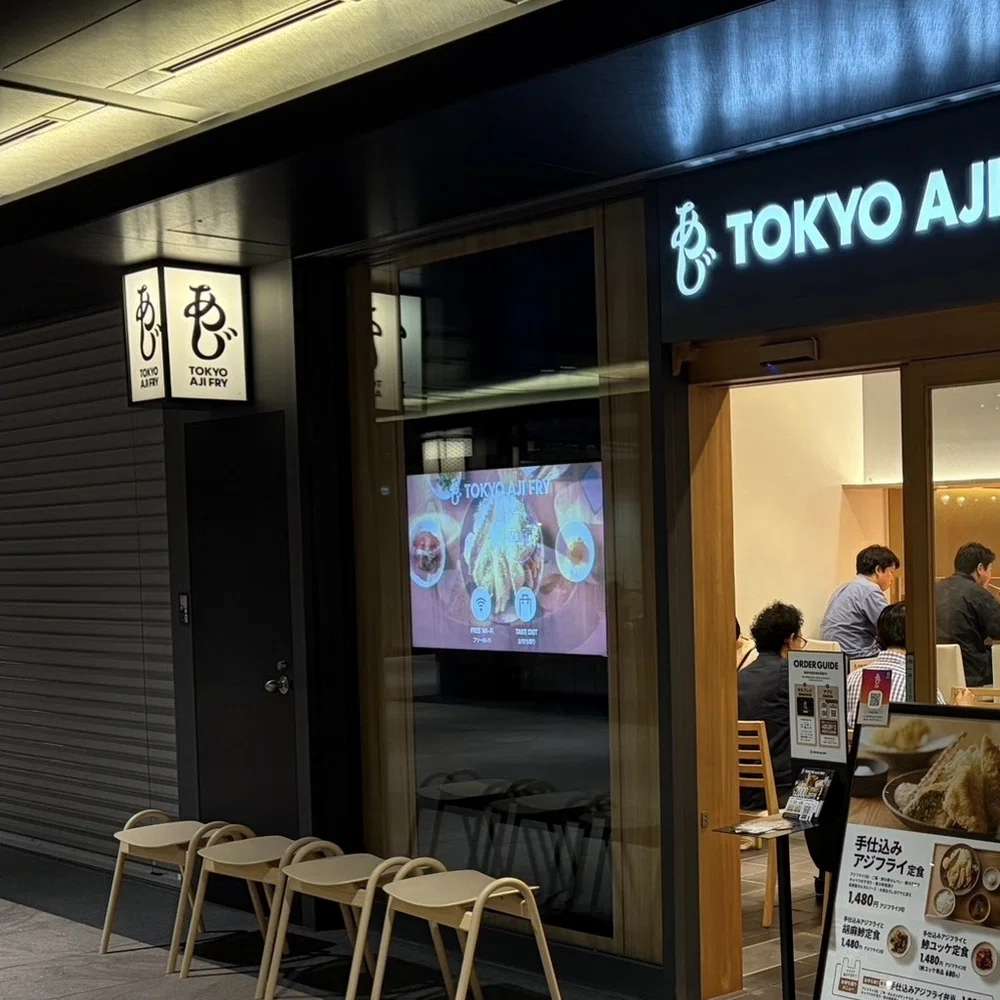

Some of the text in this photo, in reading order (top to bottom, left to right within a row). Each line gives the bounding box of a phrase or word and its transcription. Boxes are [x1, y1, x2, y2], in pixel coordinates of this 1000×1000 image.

[726, 180, 903, 266] TOKYO
[139, 366, 159, 378] TOKYO
[188, 365, 228, 377] TOKYO
[140, 377, 159, 388] AJI FRY
[189, 377, 228, 387] AJI FRY
[463, 480, 551, 499] TOKYO AJI FRY
[527, 628, 538, 636] OUT
[793, 659, 839, 670] ORDER GUIDE
[854, 835, 902, 856] 手仕込み
[853, 853, 925, 879] アジフライ定食
[848, 891, 879, 908] 1,480円
[843, 916, 885, 929] 手仕込みアジフライと
[841, 937, 863, 951] 1,480円
[923, 930, 968, 945] 手仕込みアジフライと
[920, 939, 970, 959] 鯵ユッケ定食
[920, 953, 944, 967] 1,480円
